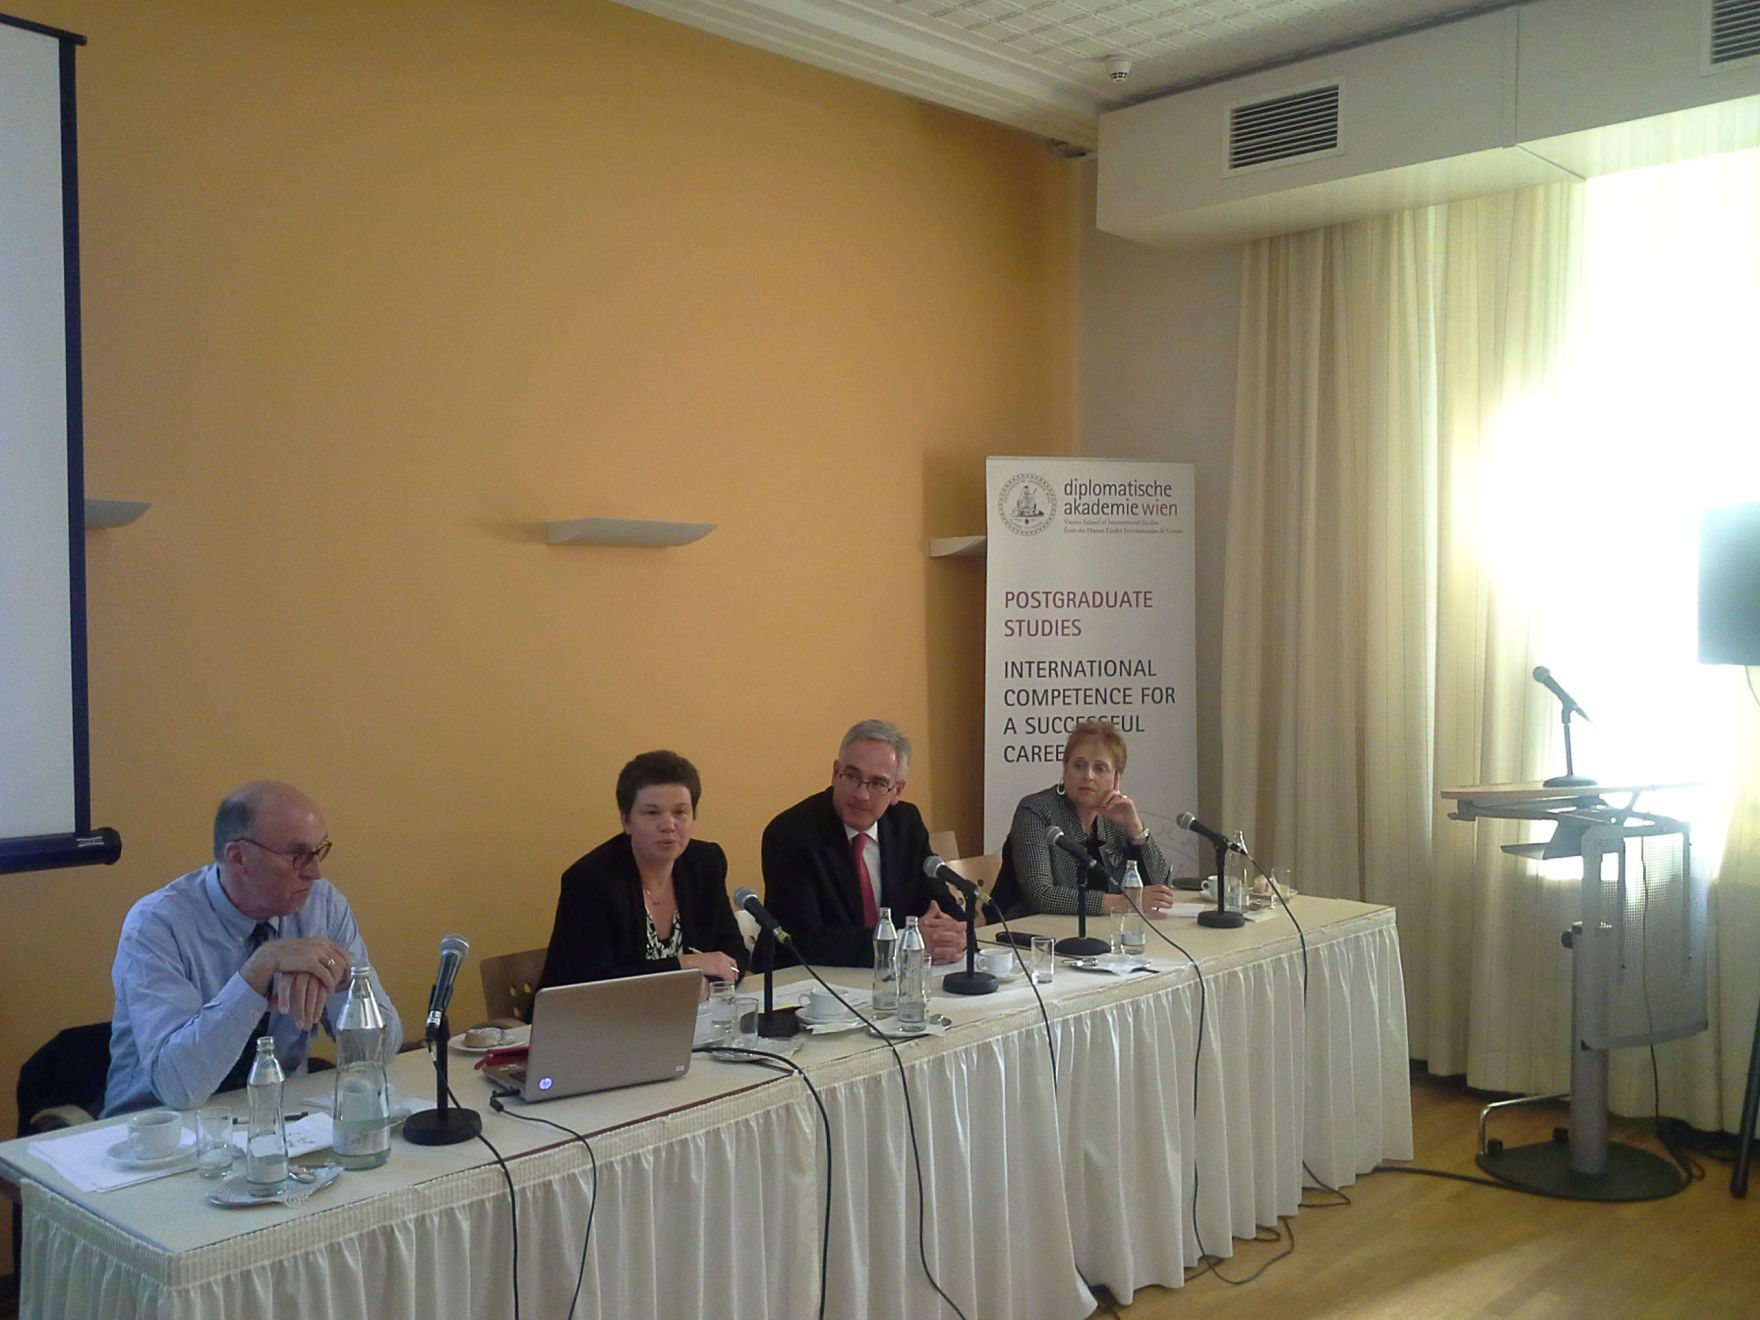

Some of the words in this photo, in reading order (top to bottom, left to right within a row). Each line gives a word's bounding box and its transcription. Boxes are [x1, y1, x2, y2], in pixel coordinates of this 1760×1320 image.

[1064, 479, 1172, 500] diplomatische
[1064, 498, 1139, 516] akademie
[1141, 499, 1178, 516] wien
[1004, 591, 1153, 609] POSTGRADUATE
[1004, 619, 1082, 637] STUDIES
[1004, 660, 1157, 678] INTERNATIONAL
[1003, 687, 1133, 706] COMPETENCE
[1141, 687, 1176, 705] FOR
[1003, 717, 1017, 735] A
[1003, 744, 1065, 763] CAREE
